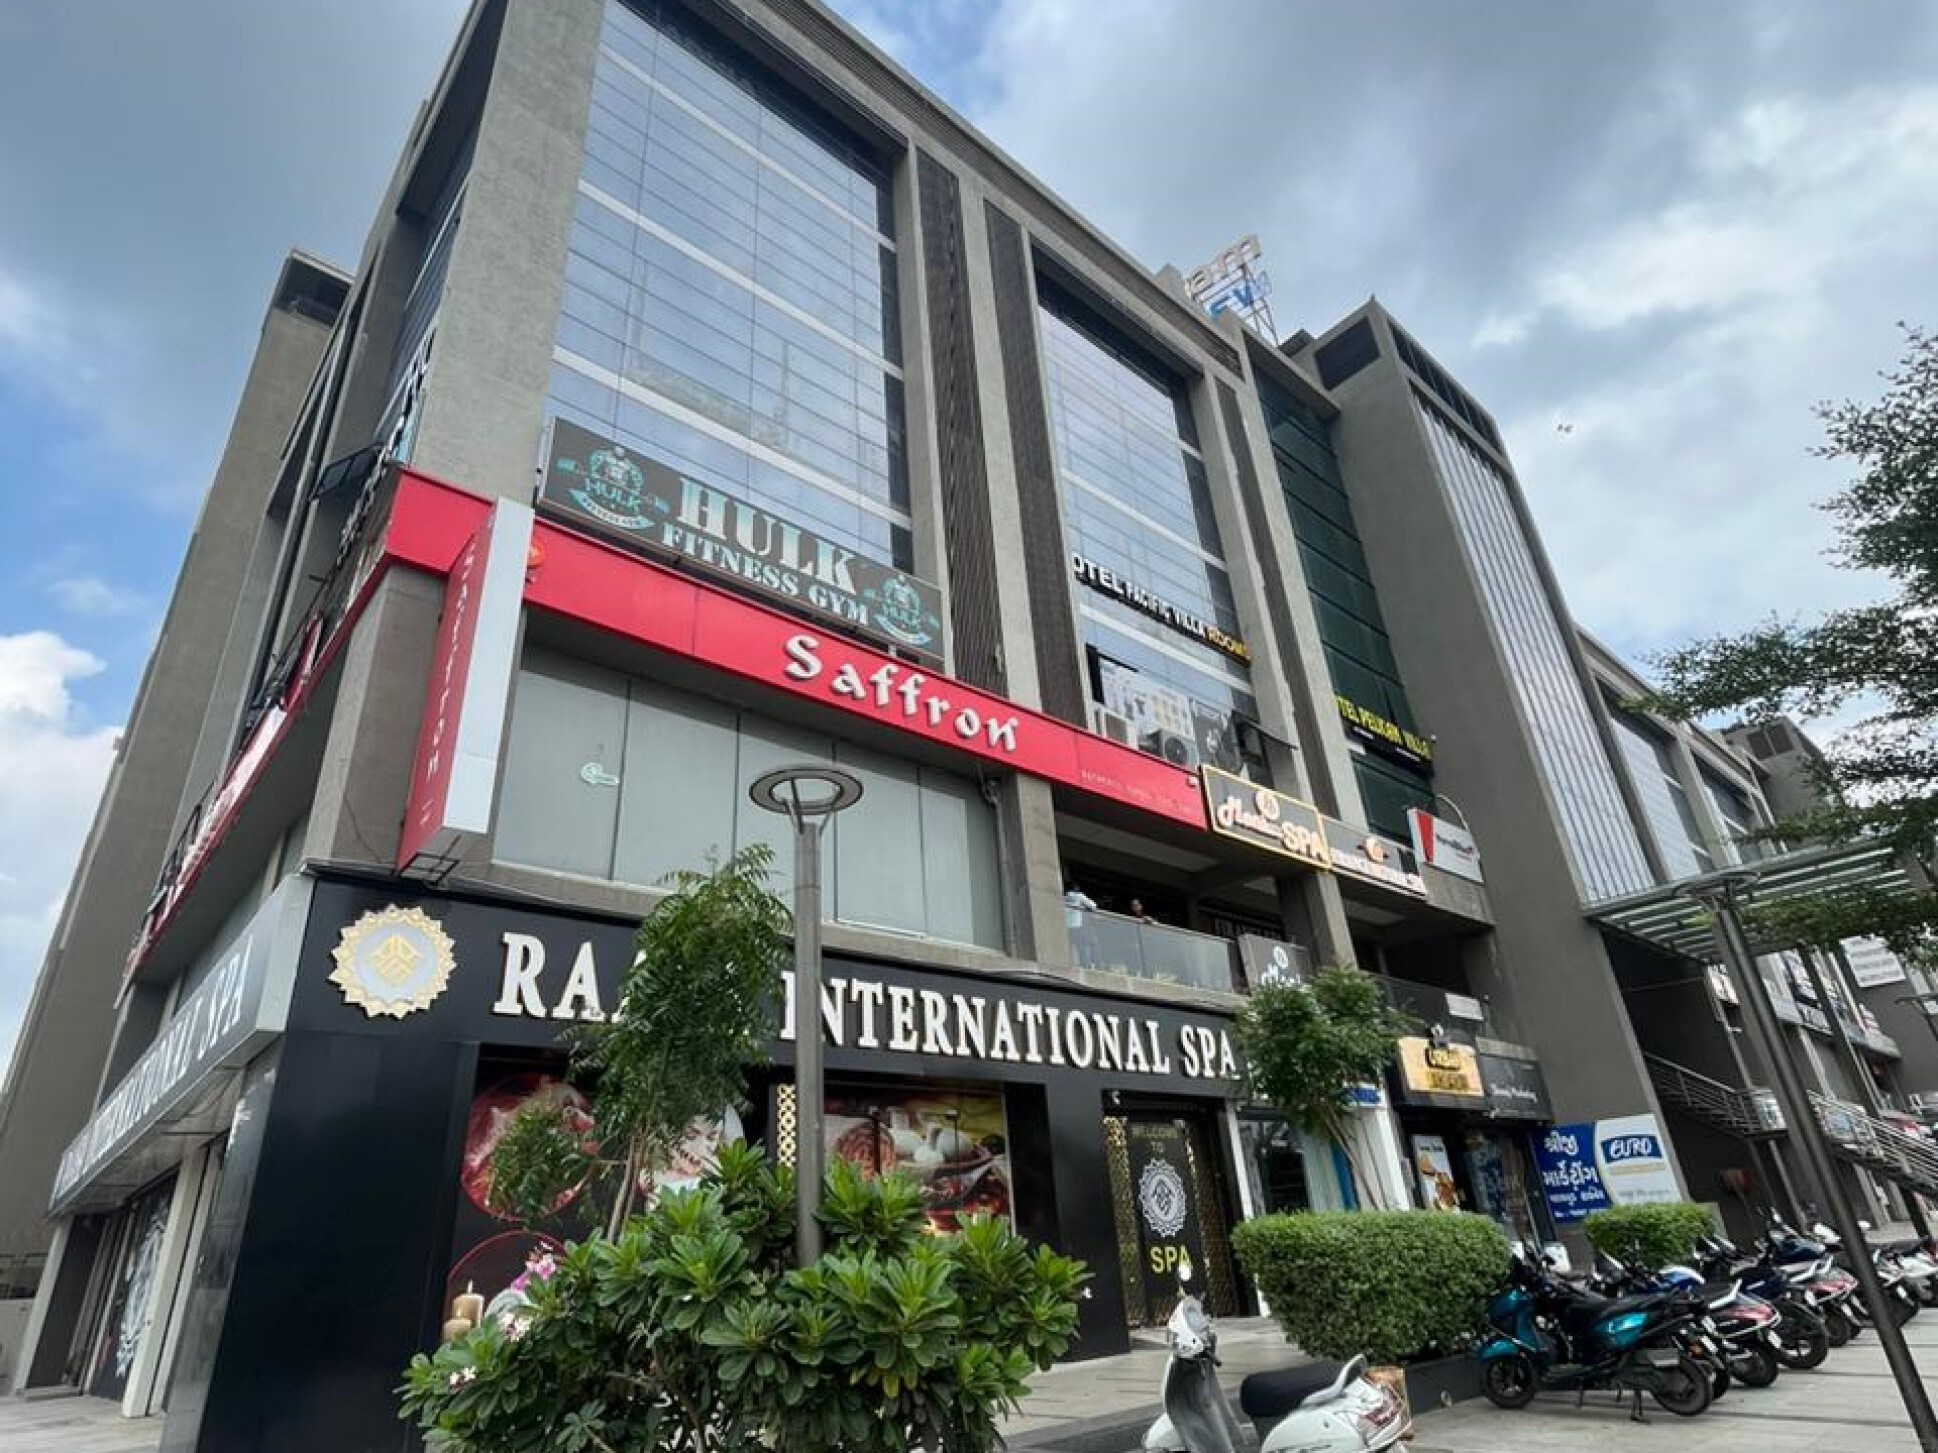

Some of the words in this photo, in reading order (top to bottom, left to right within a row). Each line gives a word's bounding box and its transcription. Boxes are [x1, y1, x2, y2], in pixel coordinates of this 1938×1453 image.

[662, 523, 799, 598] FITNESS
[808, 581, 869, 626] GYM
[678, 477, 857, 595] HULK
[784, 635, 1019, 753] Saffron
[1281, 821, 1328, 864] SPA
[779, 970, 1171, 1074] INTERNATIONAL
[1179, 1024, 1241, 1081] SPA
[1609, 1137, 1653, 1159] EURO
[1150, 1245, 1194, 1275] SPA
